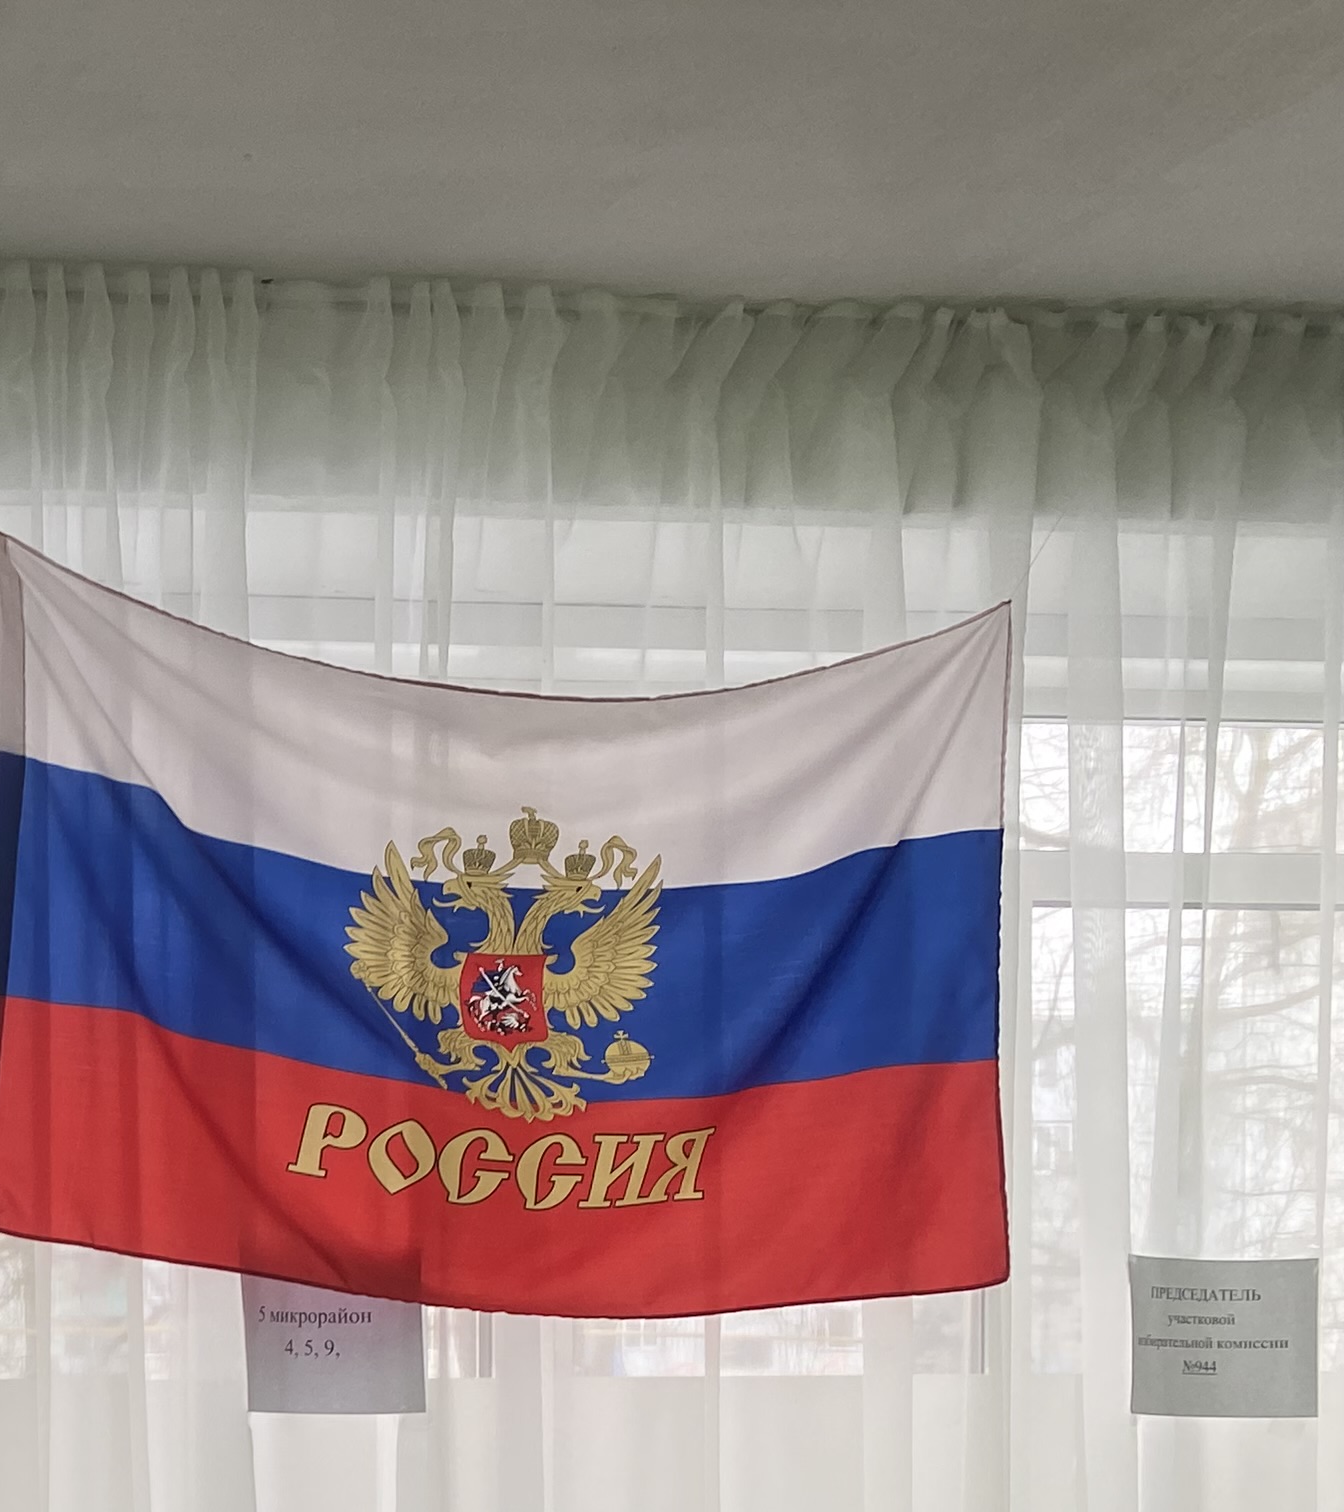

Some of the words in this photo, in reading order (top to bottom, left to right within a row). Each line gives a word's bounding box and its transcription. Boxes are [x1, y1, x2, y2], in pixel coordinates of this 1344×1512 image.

[286, 1102, 716, 1211] РОССИЯ
[1151, 1285, 1262, 1302] ПРЕДСЕДАТЕЛЬ
[258, 1305, 266, 1323] 5
[269, 1307, 372, 1328] микрорайон
[1167, 1314, 1236, 1327] участковой
[284, 1338, 299, 1359] 4,
[304, 1339, 319, 1359] 5,
[323, 1339, 341, 1359] 9,
[1217, 1339, 1289, 1350] комиссии
